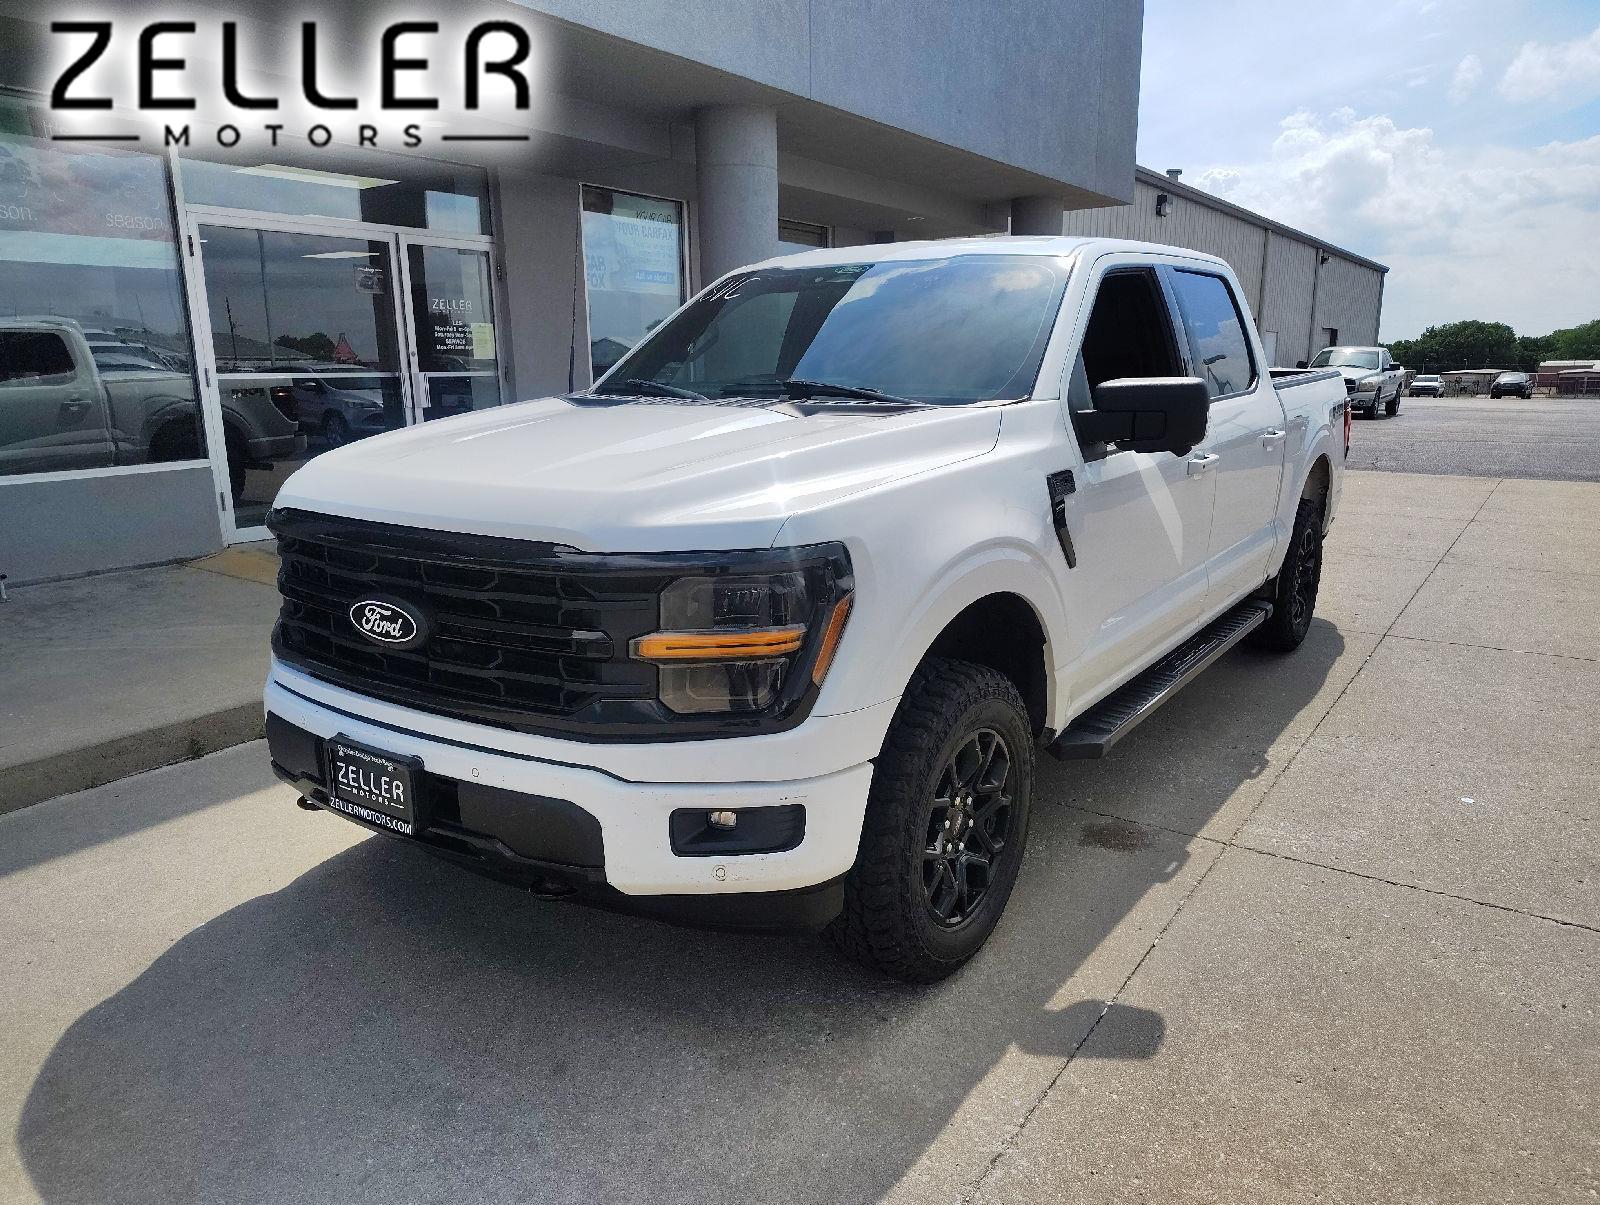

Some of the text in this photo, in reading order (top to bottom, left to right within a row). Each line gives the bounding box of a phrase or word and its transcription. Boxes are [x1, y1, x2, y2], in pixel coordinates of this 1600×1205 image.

[432, 298, 472, 310] ZELLER
[361, 606, 402, 637] Ford
[336, 761, 404, 803] ZELLER
[352, 787, 389, 806] MOTORS
[330, 797, 412, 836] ZELLERMOTORS.COM
